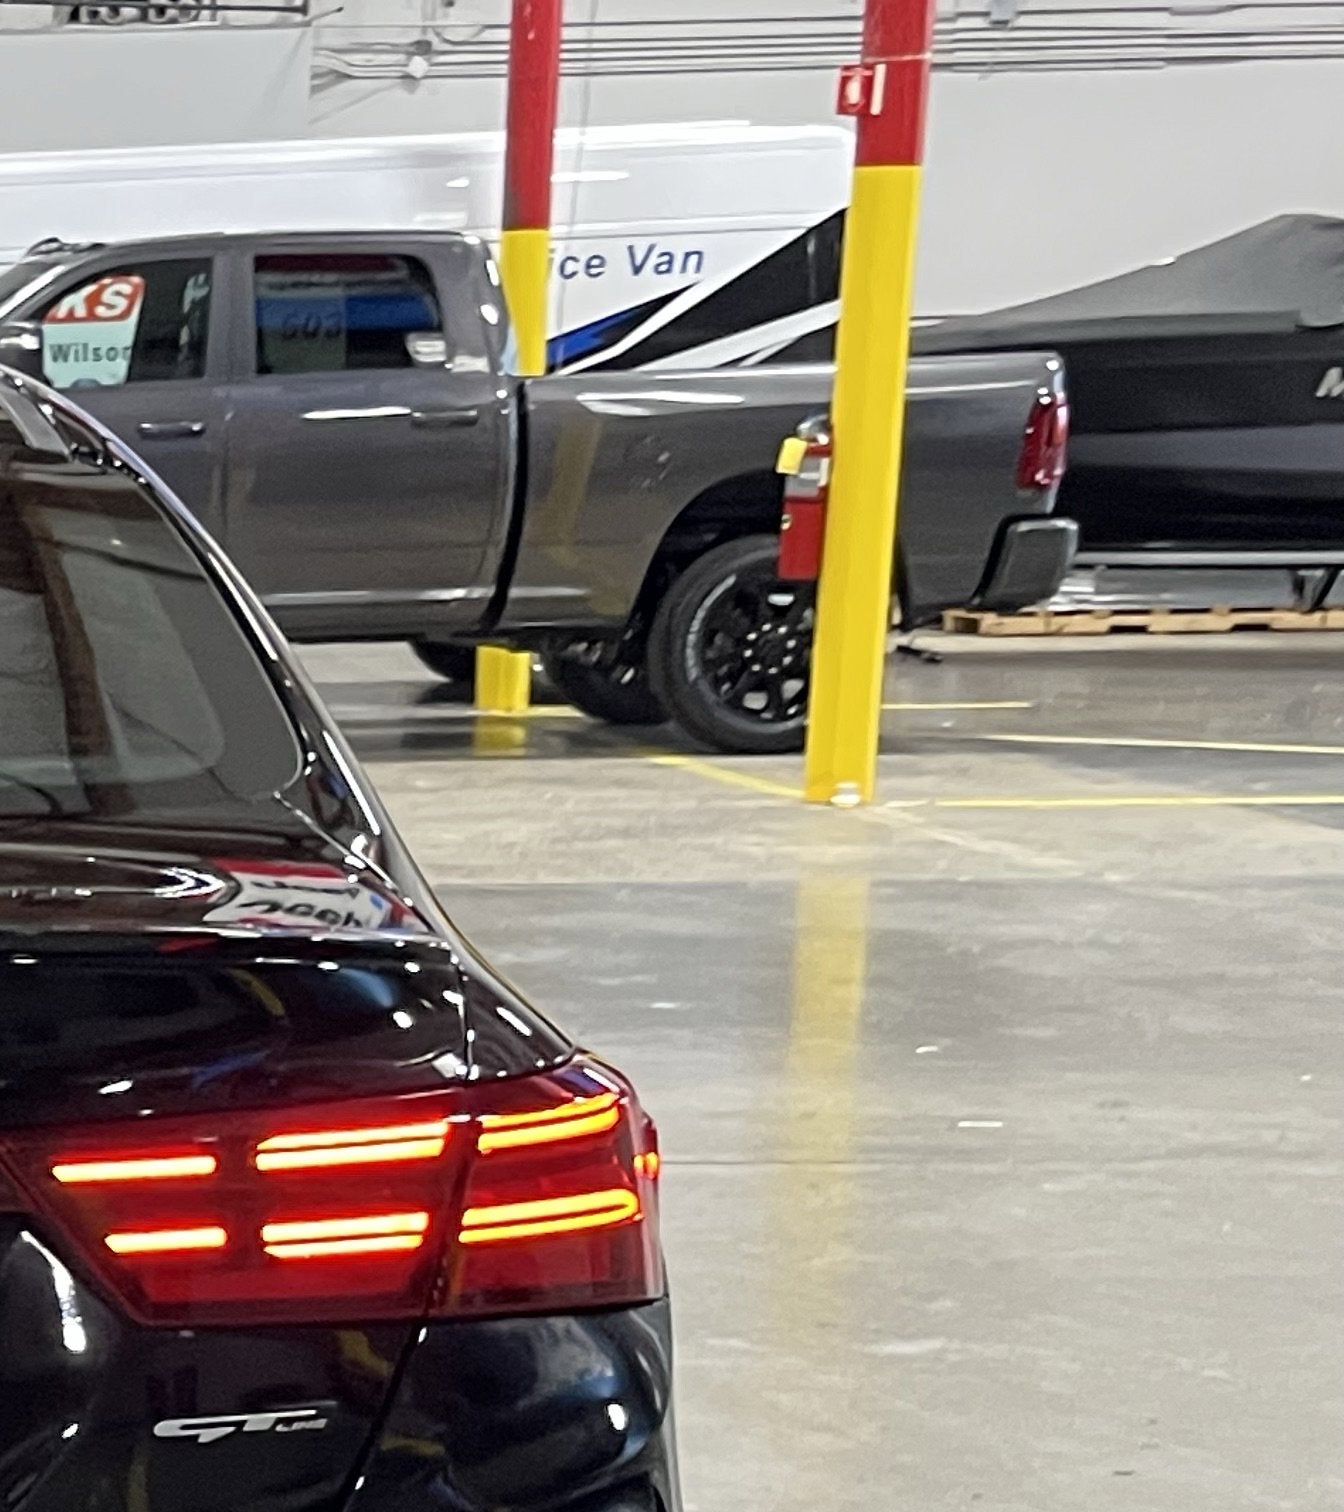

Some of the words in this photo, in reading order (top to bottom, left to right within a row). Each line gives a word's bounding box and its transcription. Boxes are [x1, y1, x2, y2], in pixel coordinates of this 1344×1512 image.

[548, 247, 607, 279] ice
[626, 243, 705, 277] Van
[54, 282, 133, 318] KS
